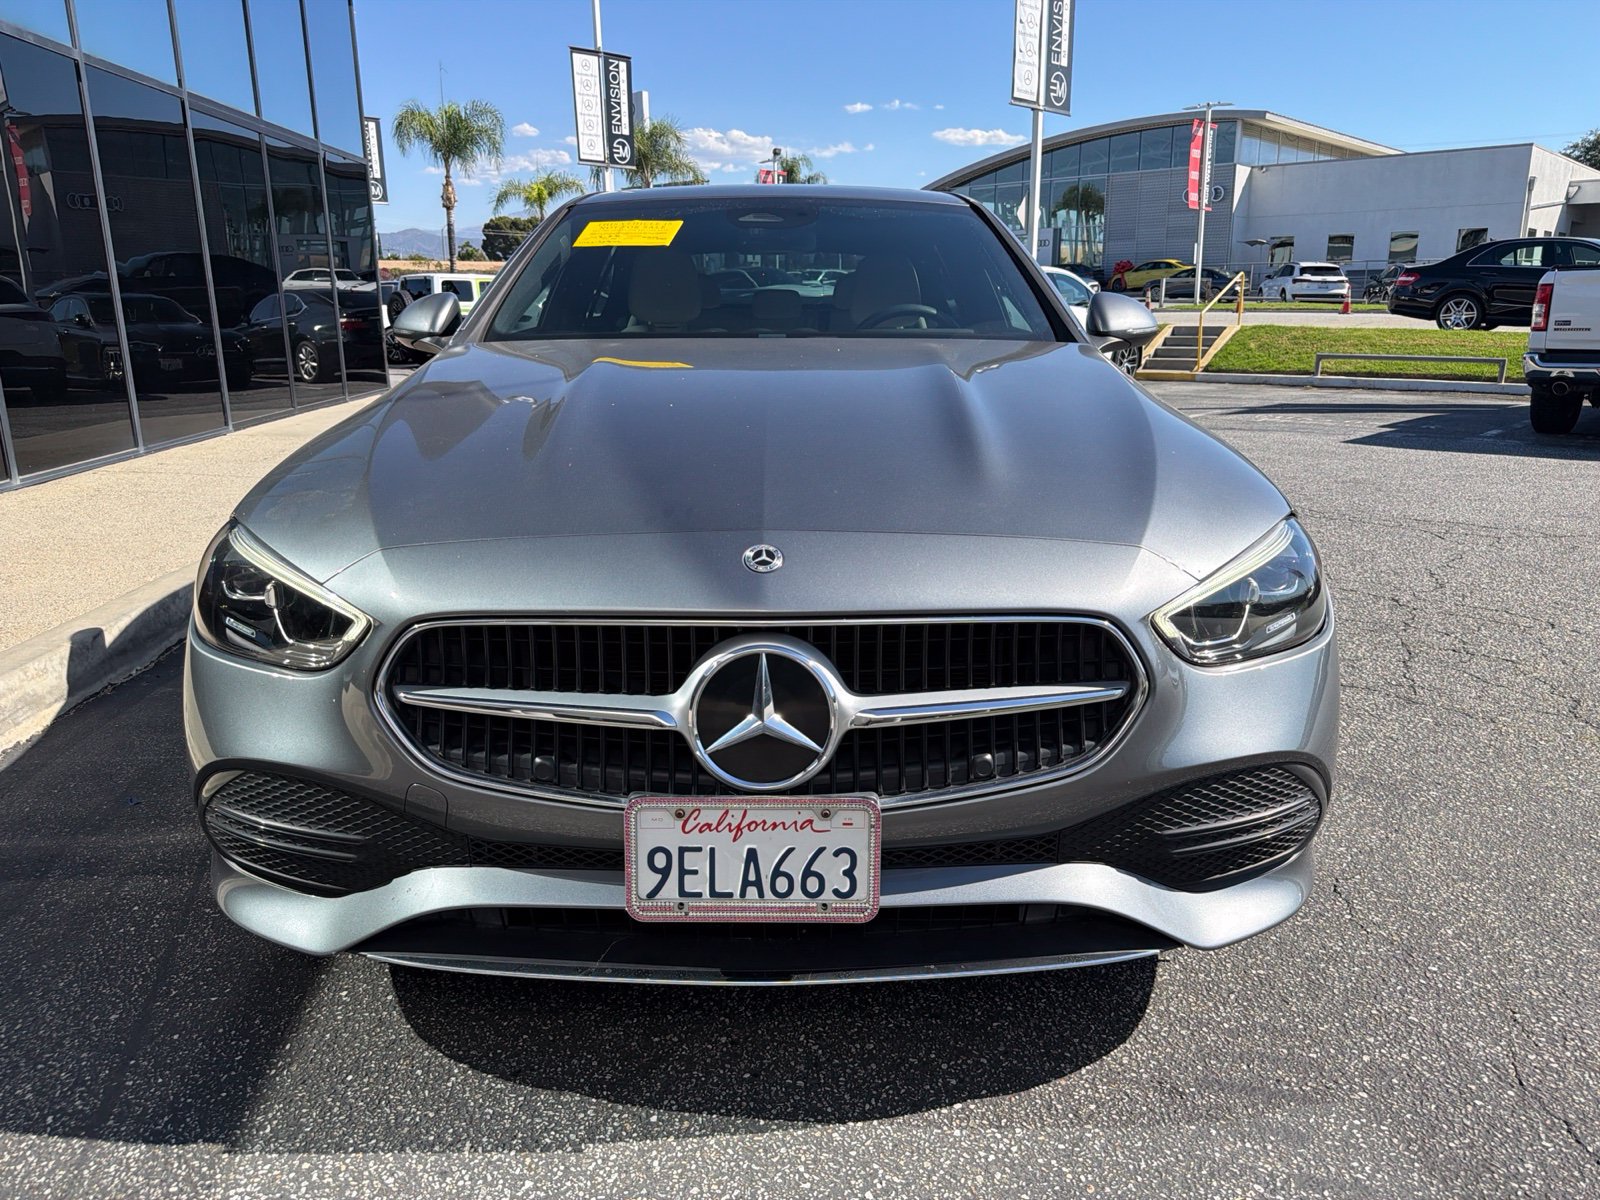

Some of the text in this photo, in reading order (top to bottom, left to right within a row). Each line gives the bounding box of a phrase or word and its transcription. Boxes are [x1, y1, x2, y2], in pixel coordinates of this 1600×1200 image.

[609, 59, 622, 135] ENVISION
[681, 808, 831, 842] California
[645, 846, 858, 899] 9ELA663
